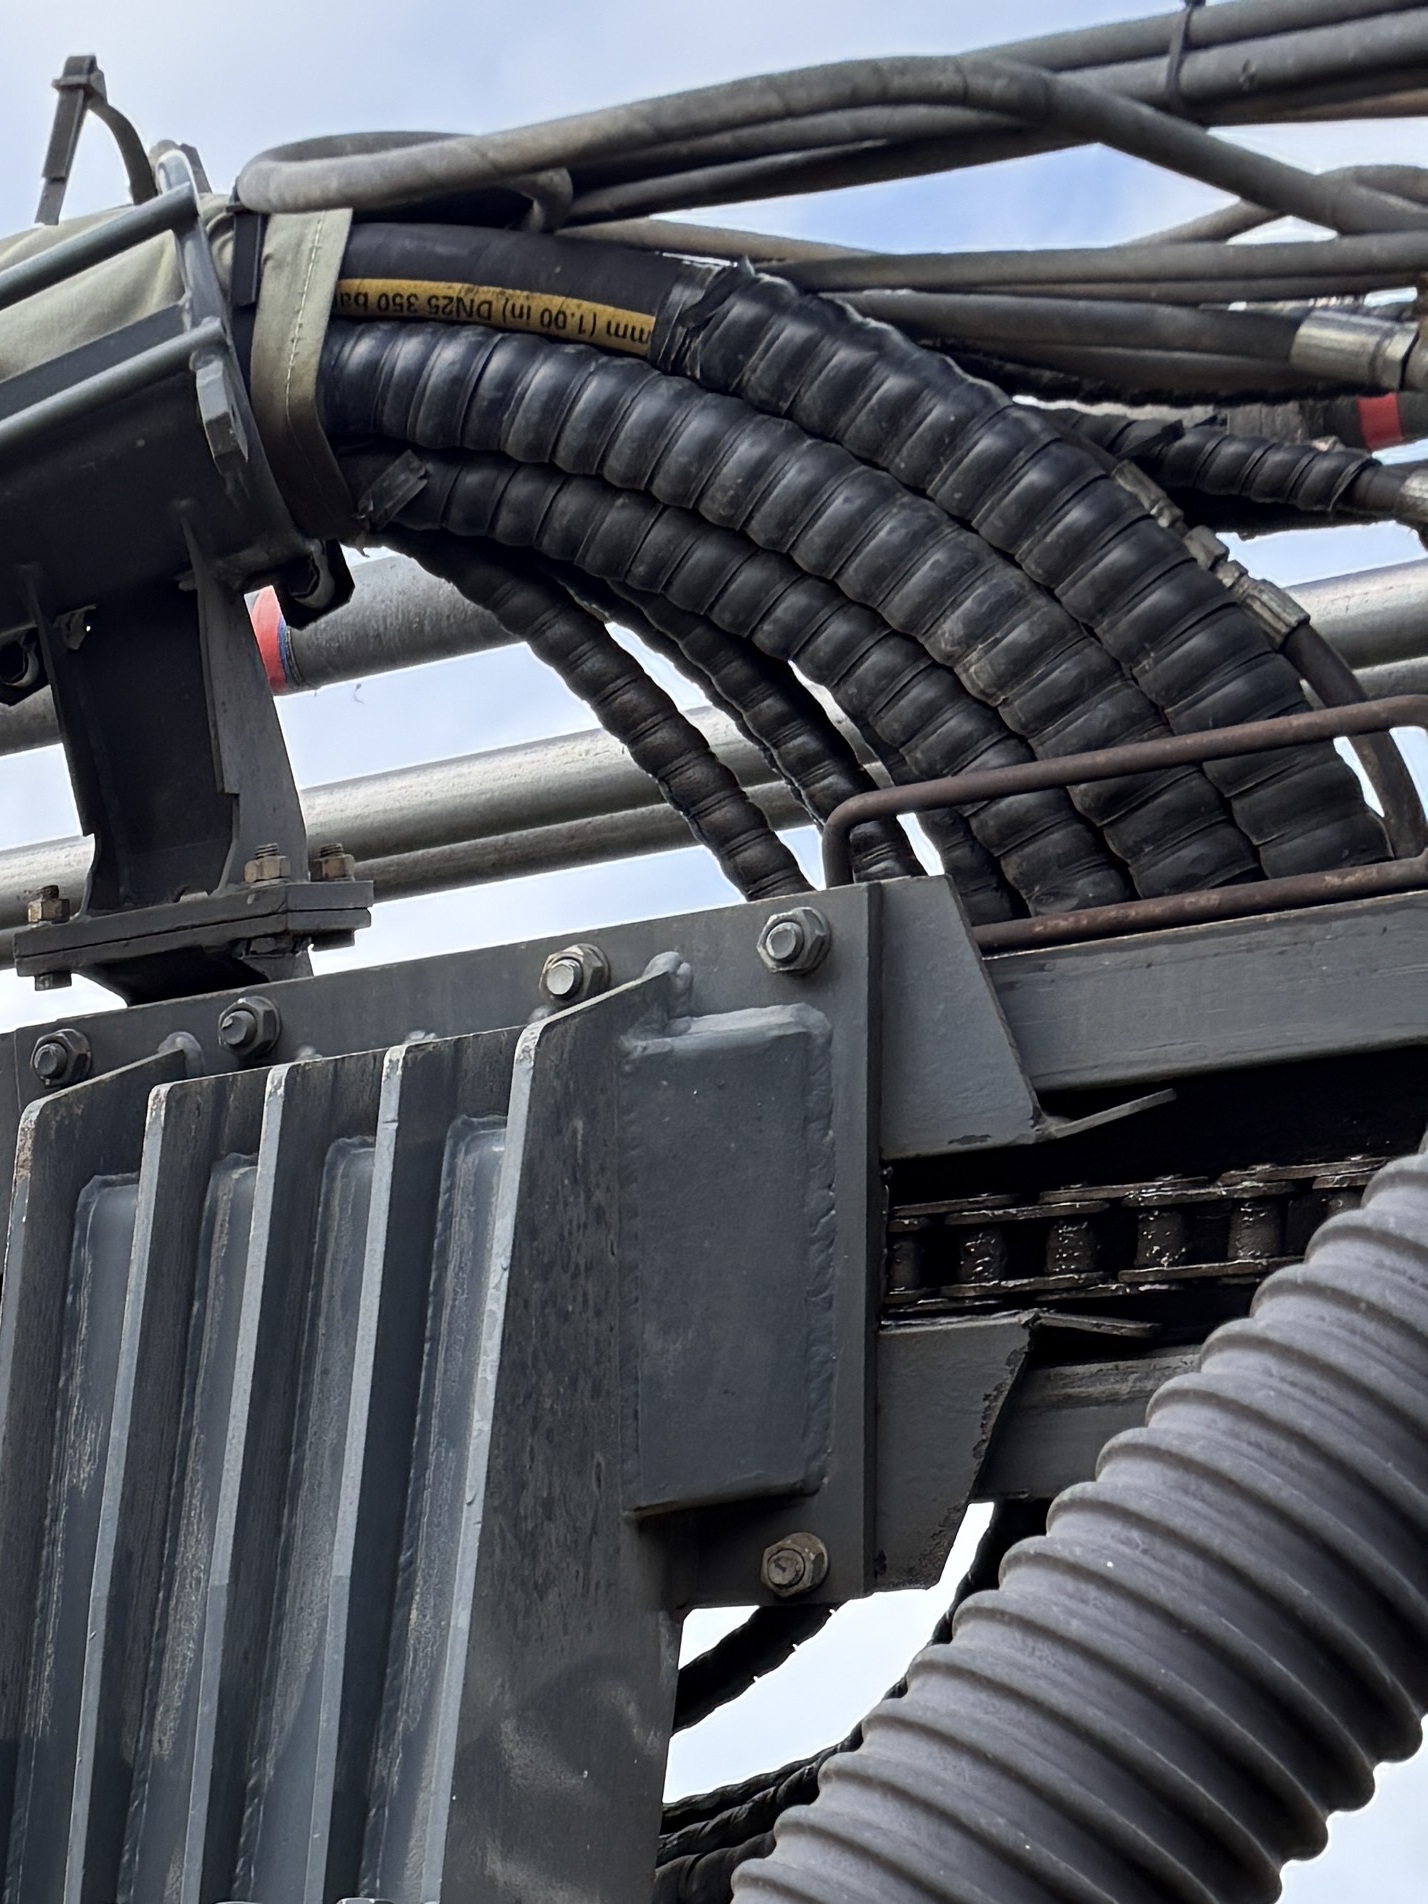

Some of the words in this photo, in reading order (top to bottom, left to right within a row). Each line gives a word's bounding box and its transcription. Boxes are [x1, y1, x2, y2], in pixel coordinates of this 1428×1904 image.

[335, 290, 369, 312] ba
[375, 291, 419, 314] 350
[426, 293, 494, 321] DN25
[501, 297, 533, 324] in)
[539, 306, 598, 340] (1.00
[607, 321, 653, 346] mm
